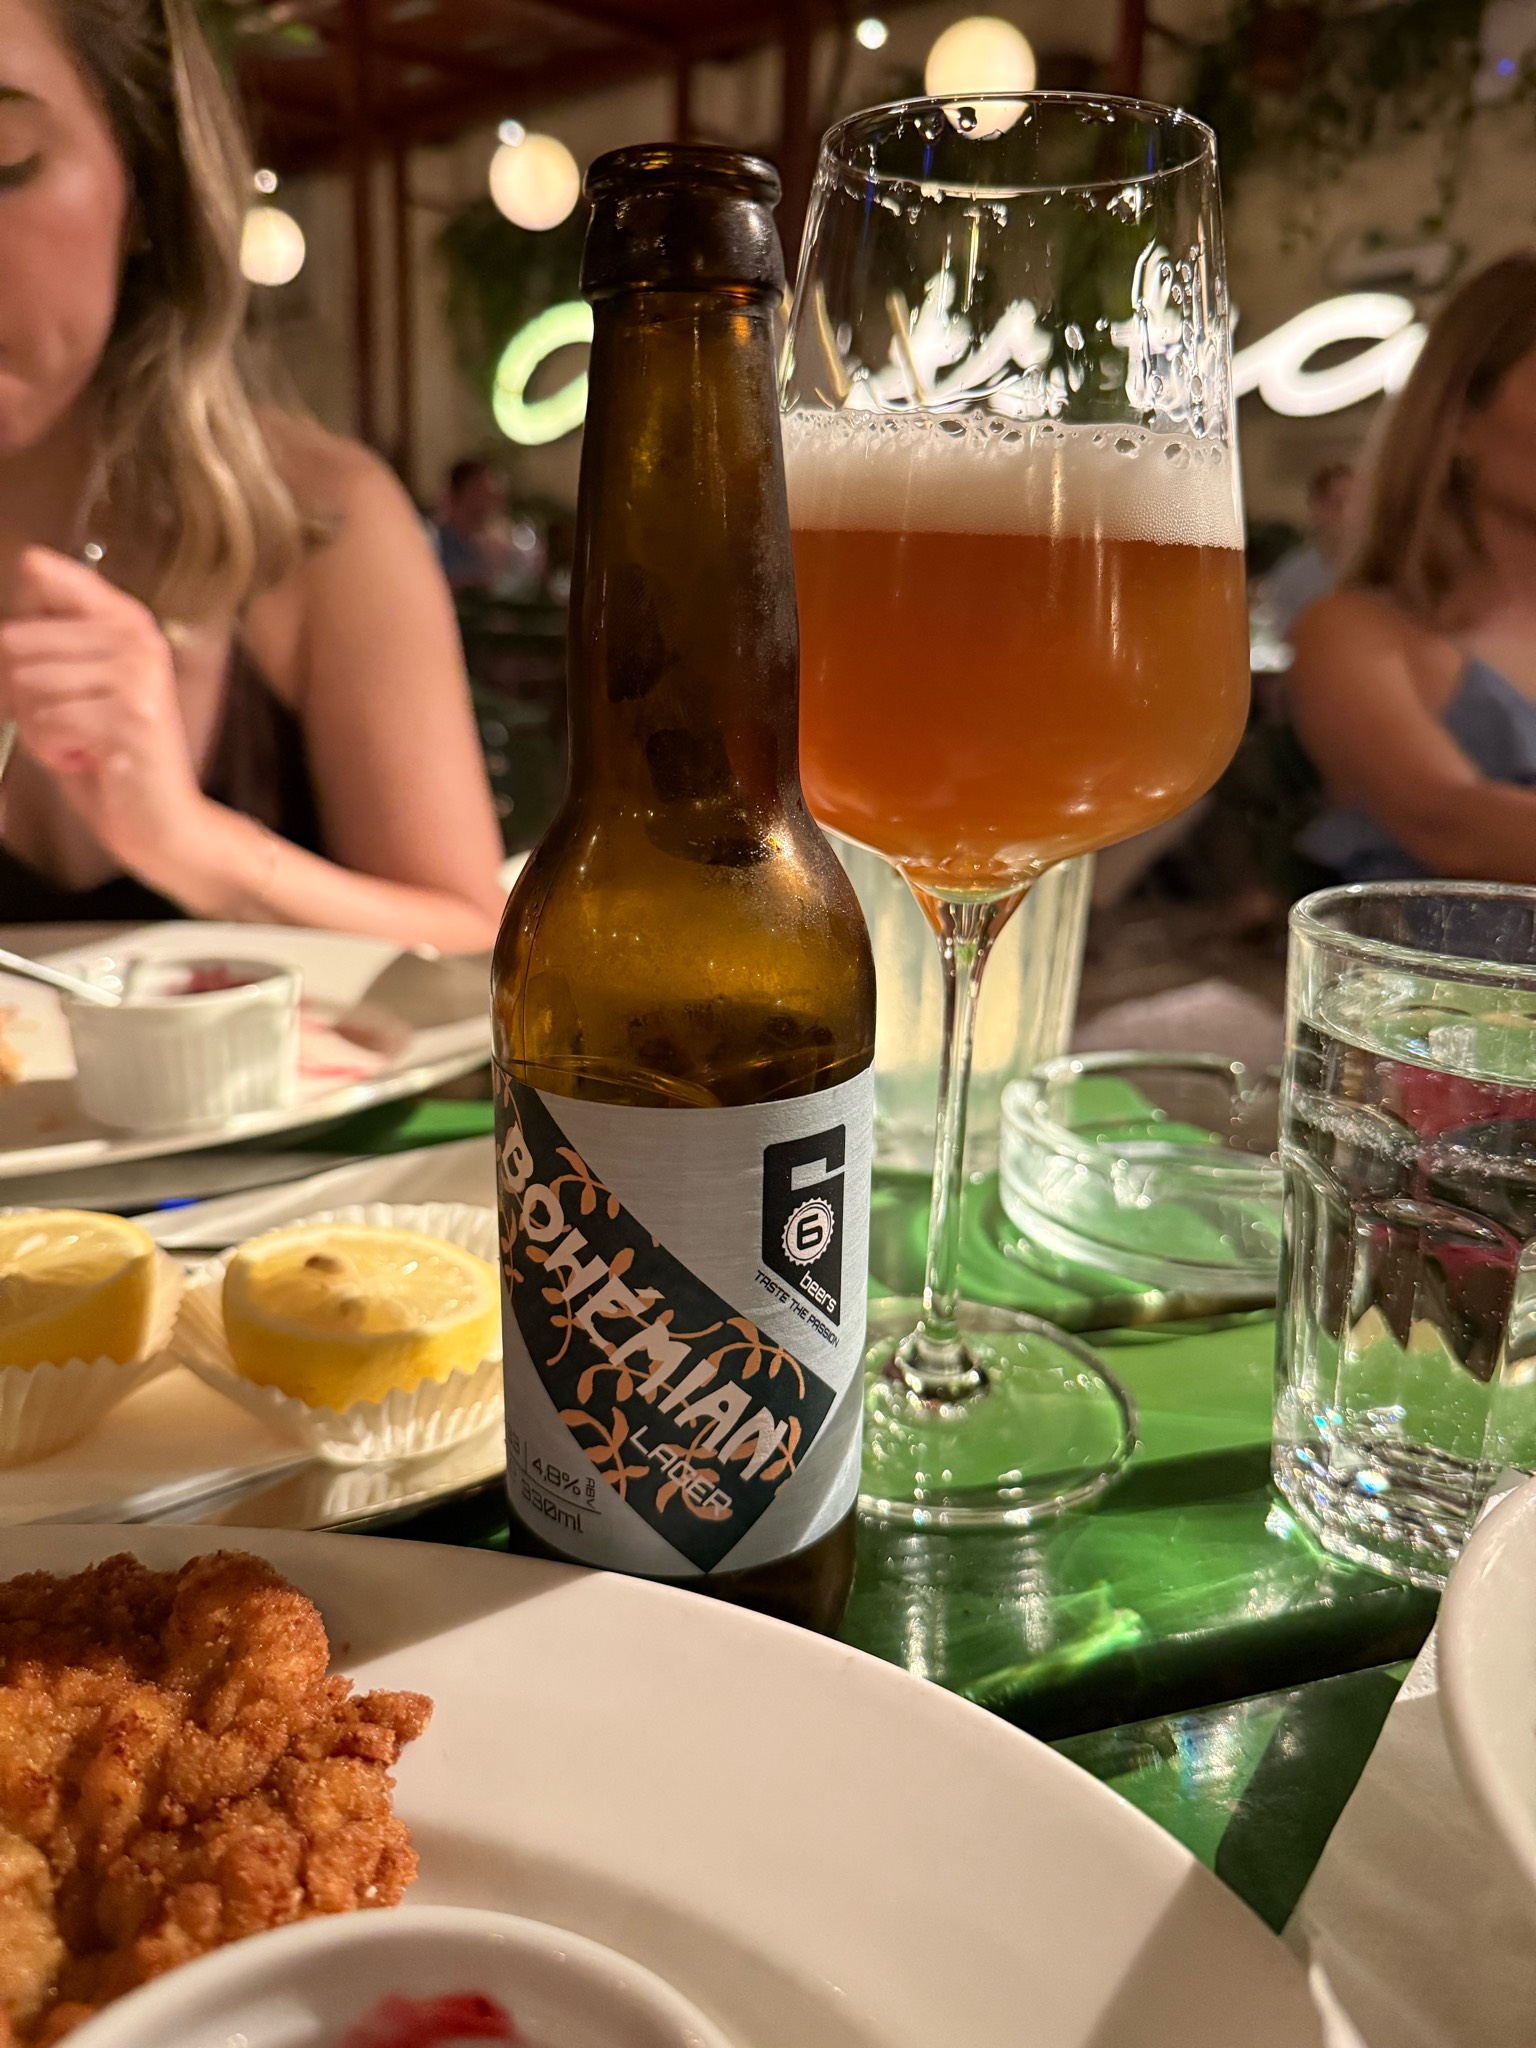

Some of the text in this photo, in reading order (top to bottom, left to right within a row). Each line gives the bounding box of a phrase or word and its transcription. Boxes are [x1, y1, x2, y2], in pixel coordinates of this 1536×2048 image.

[755, 1269, 840, 1348] TASTE THE PASSION
[799, 1270, 837, 1313] beers
[585, 1477, 596, 1509] ABV
[630, 1424, 733, 1516] LAGER
[521, 1478, 583, 1534] 330ml
